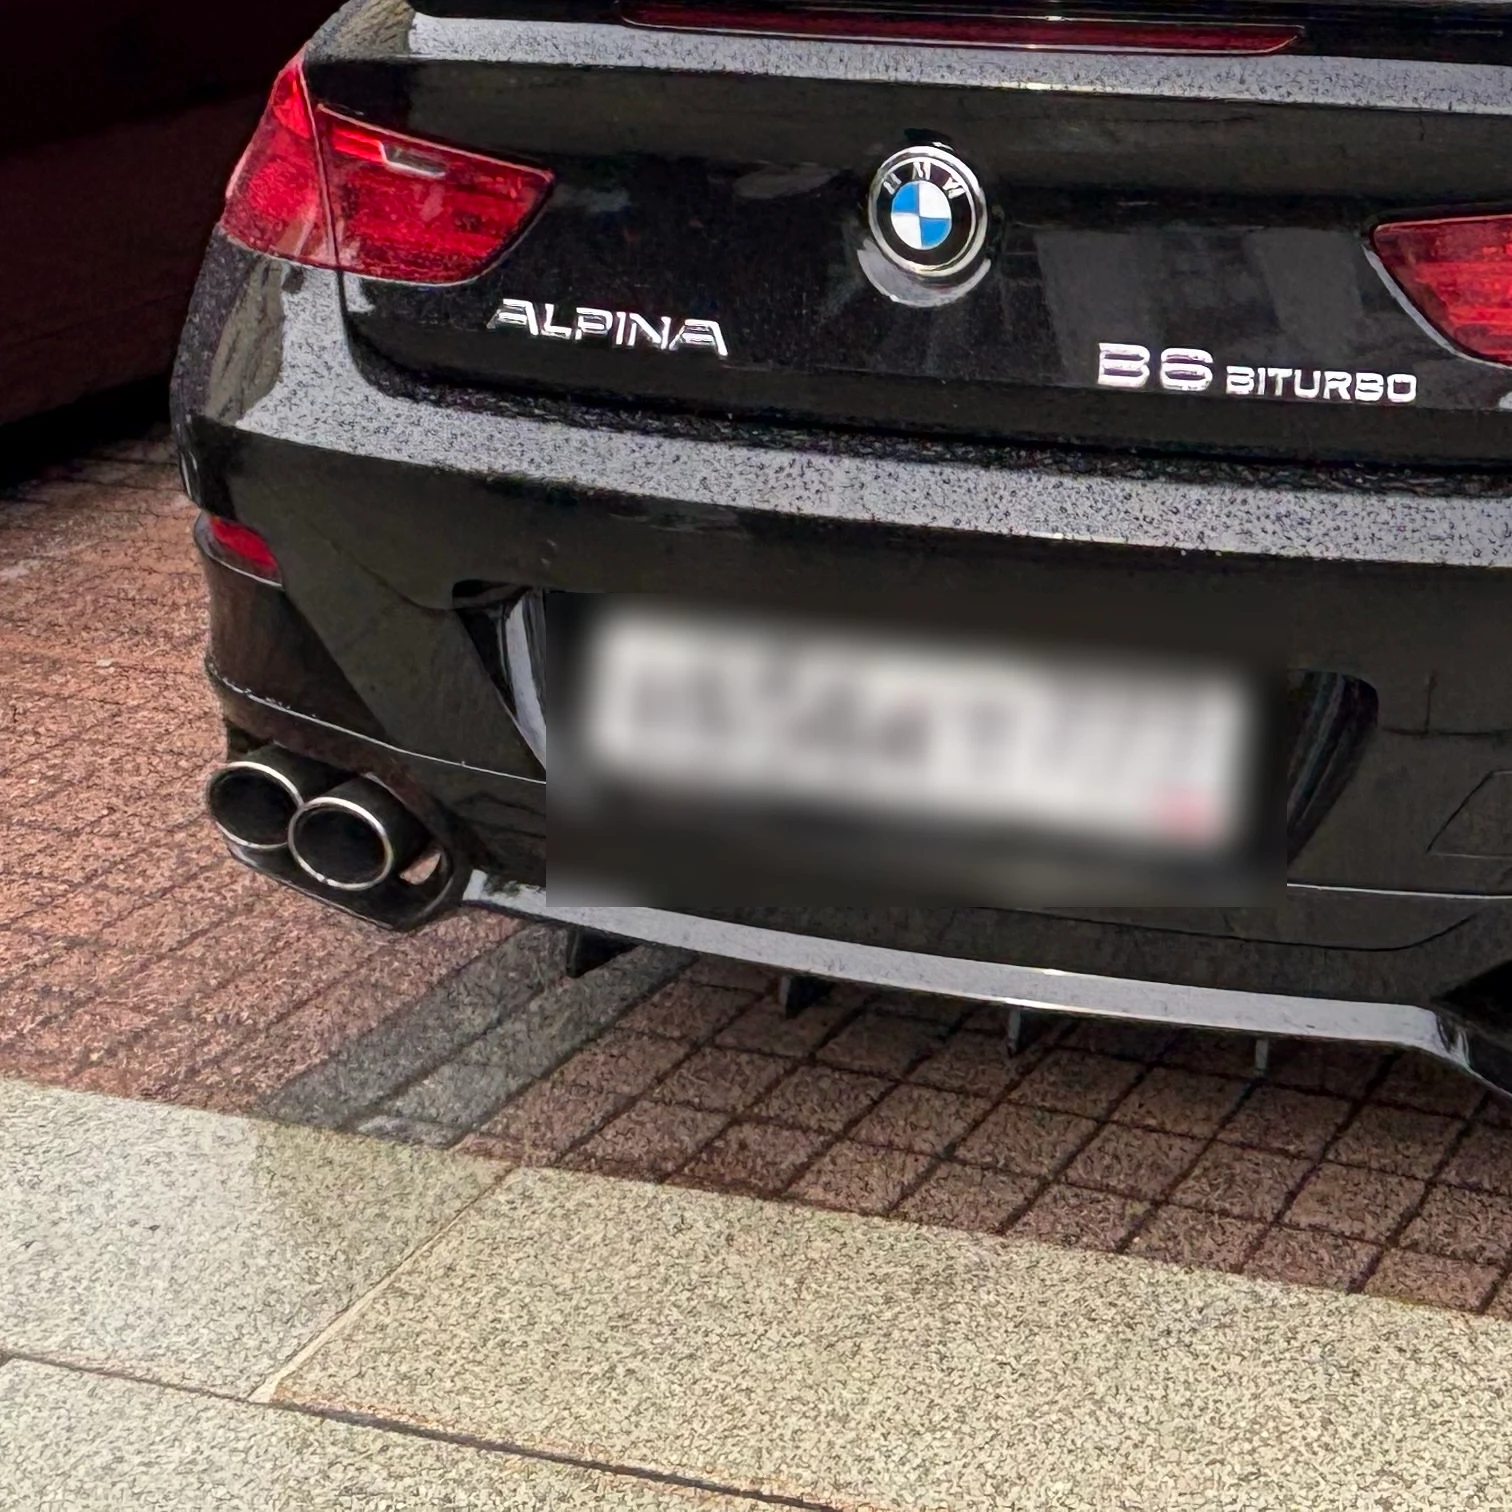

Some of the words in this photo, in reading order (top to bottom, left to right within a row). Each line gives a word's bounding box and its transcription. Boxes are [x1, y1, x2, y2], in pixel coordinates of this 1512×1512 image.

[883, 161, 966, 199] BMW
[486, 298, 728, 357] ALPINA
[1097, 342, 1214, 392] B6
[1226, 366, 1417, 403] BITURBO
